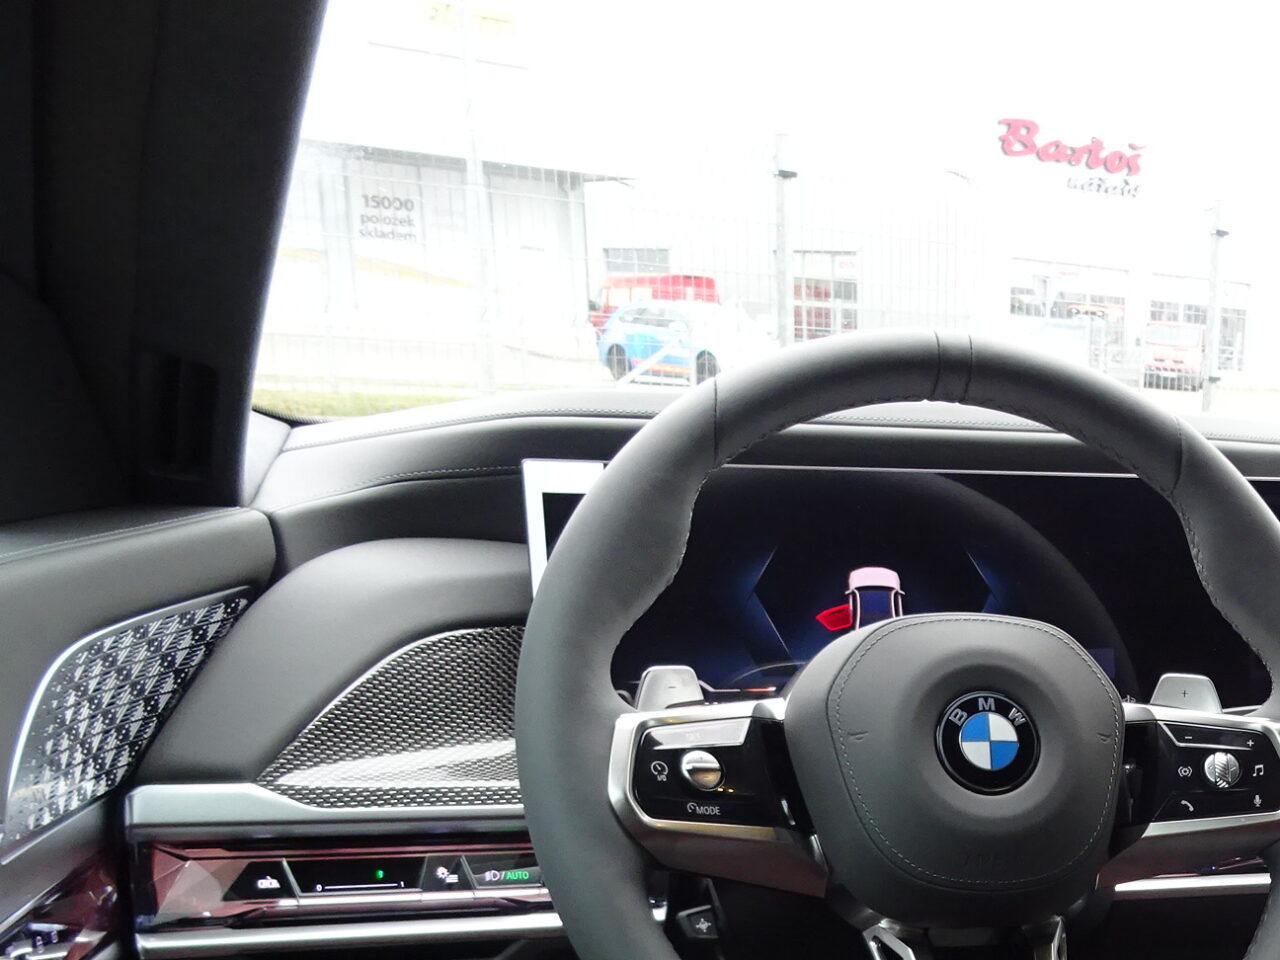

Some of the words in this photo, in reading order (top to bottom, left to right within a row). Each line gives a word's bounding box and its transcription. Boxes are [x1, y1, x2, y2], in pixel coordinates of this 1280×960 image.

[998, 118, 1148, 177] Bartoš
[361, 194, 415, 212] 15000
[948, 697, 1027, 727] BMW
[696, 806, 721, 815] MODE
[506, 871, 529, 880] AUTO
